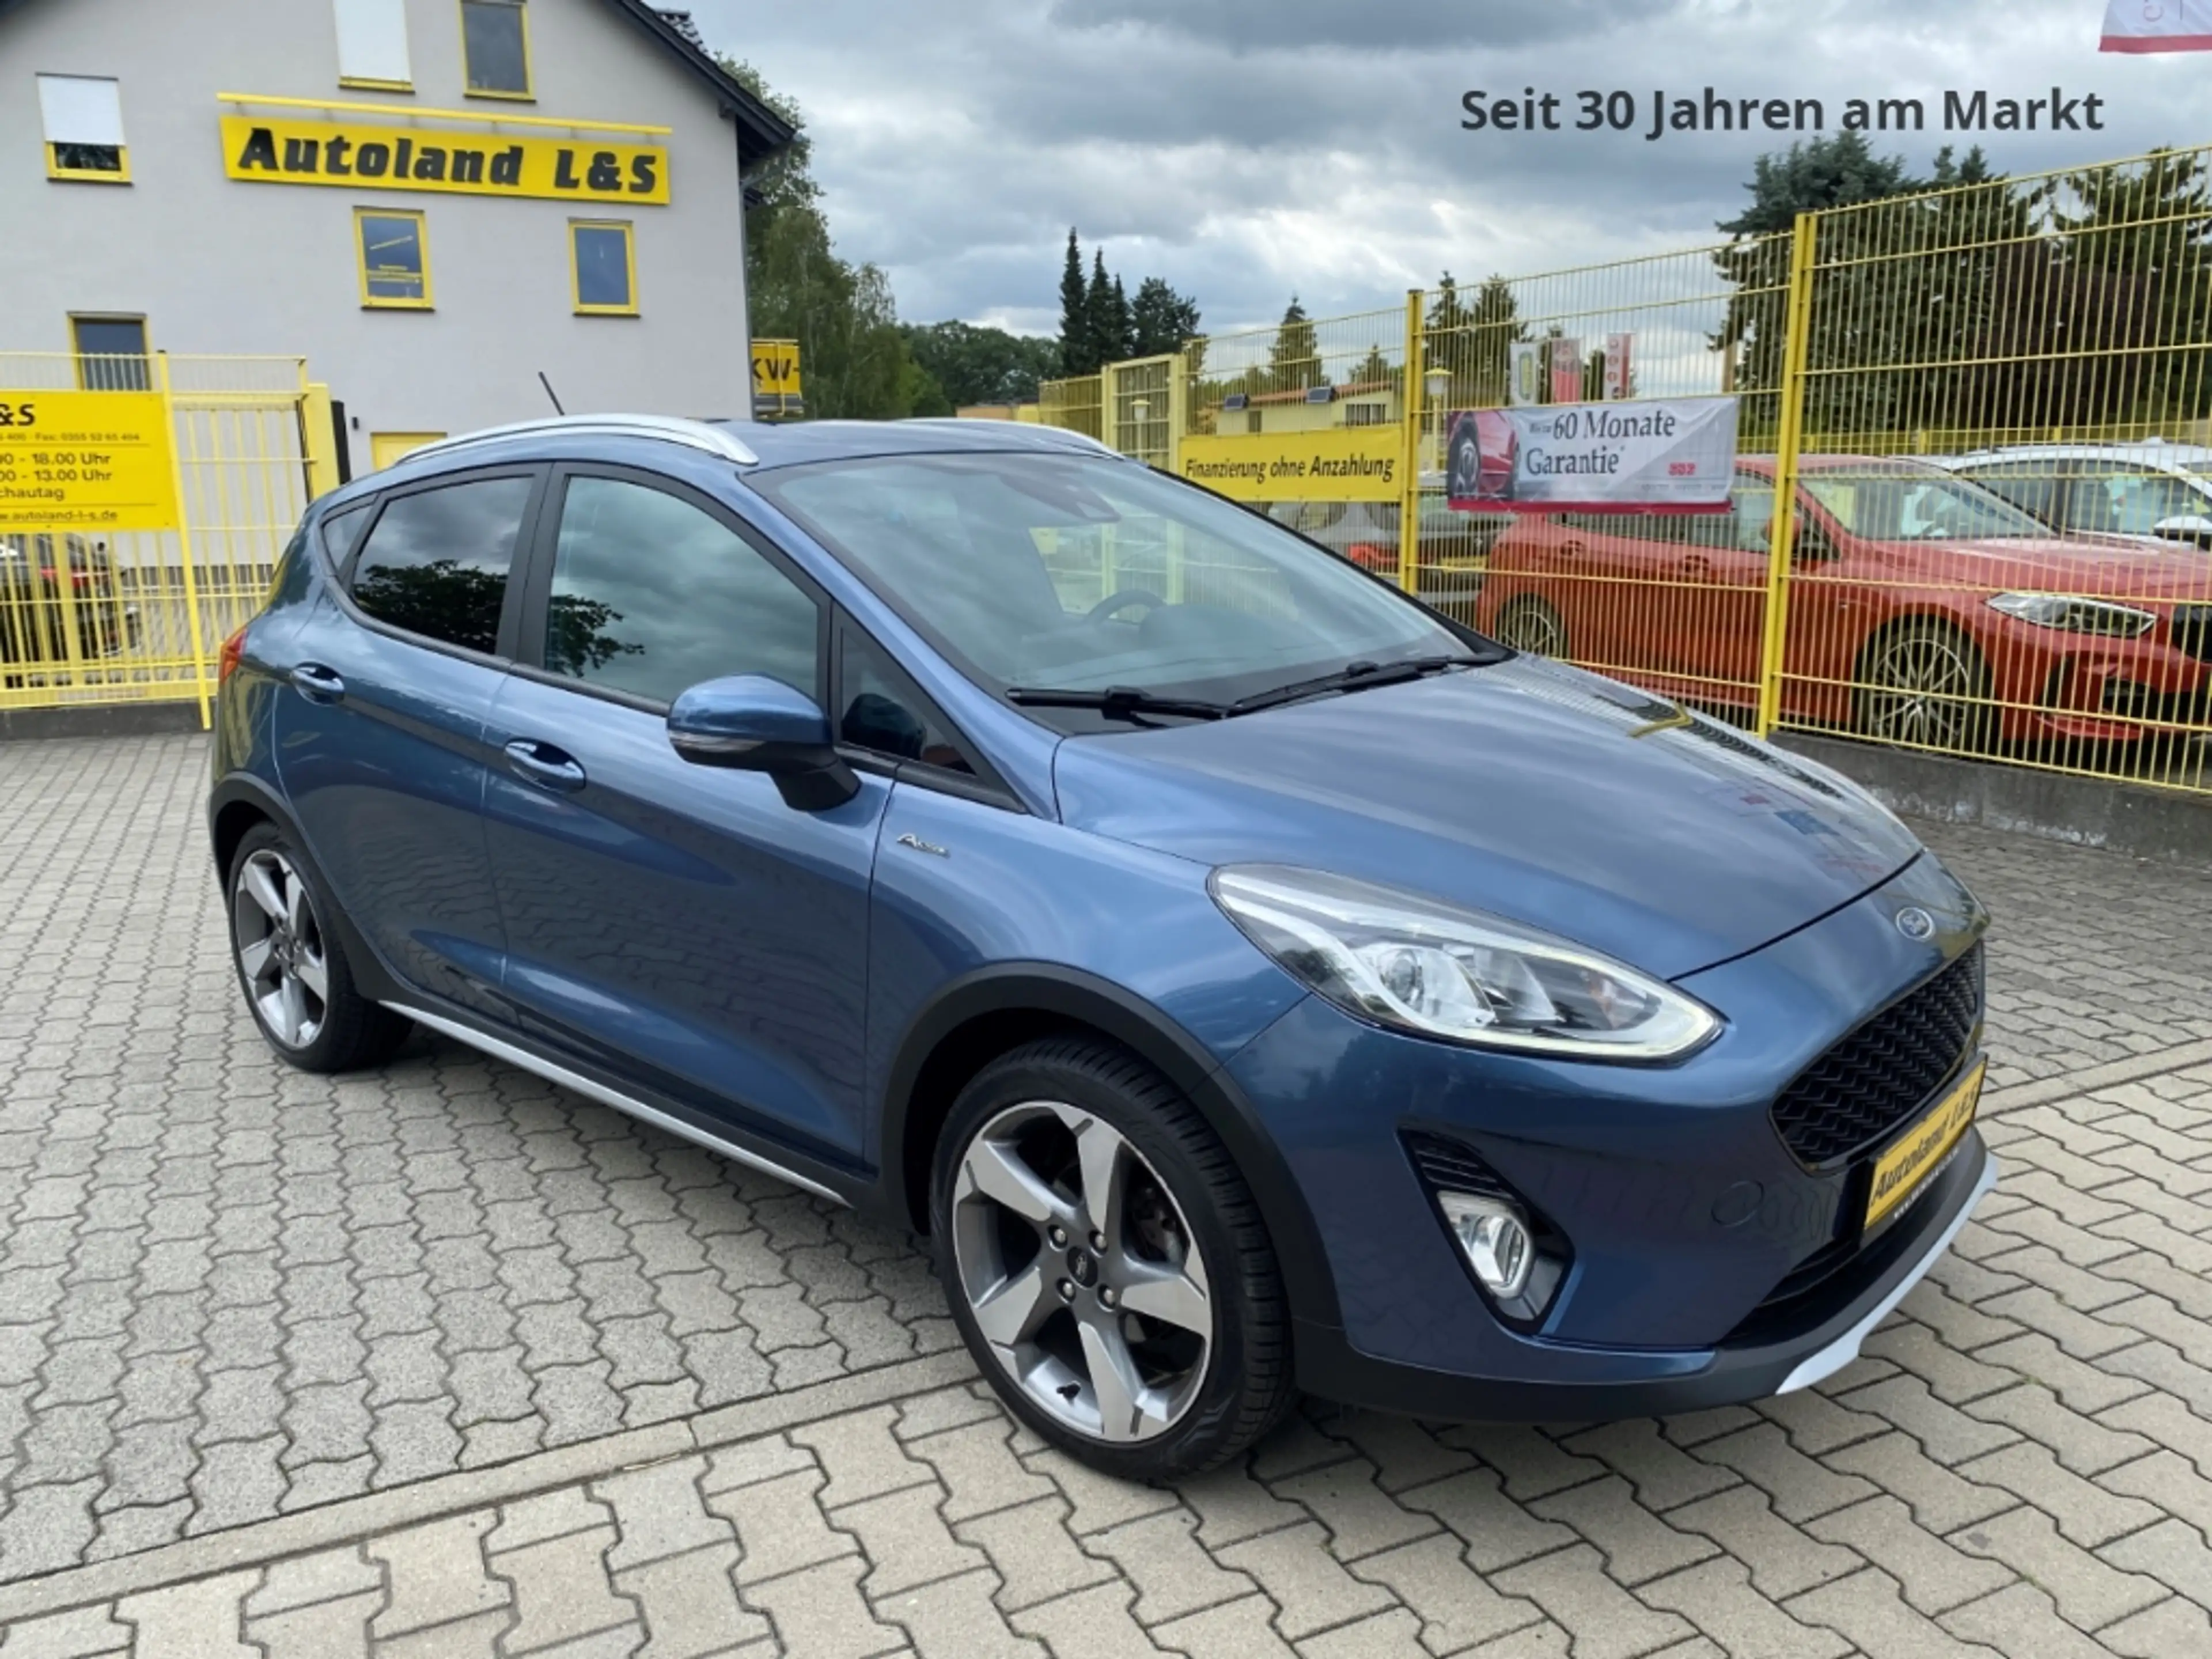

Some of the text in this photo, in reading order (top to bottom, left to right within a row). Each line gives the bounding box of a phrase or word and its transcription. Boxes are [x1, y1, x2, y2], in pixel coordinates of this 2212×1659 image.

[238, 127, 657, 194] Autoland L&S
[1553, 410, 1676, 440] 60 Monate
[32, 452, 77, 465] 18.00
[80, 452, 111, 465] Uhr
[1185, 453, 1395, 484] Finanzierung ohne Anzahlung
[33, 469, 78, 482] 13.00
[82, 469, 113, 482] Uhr
